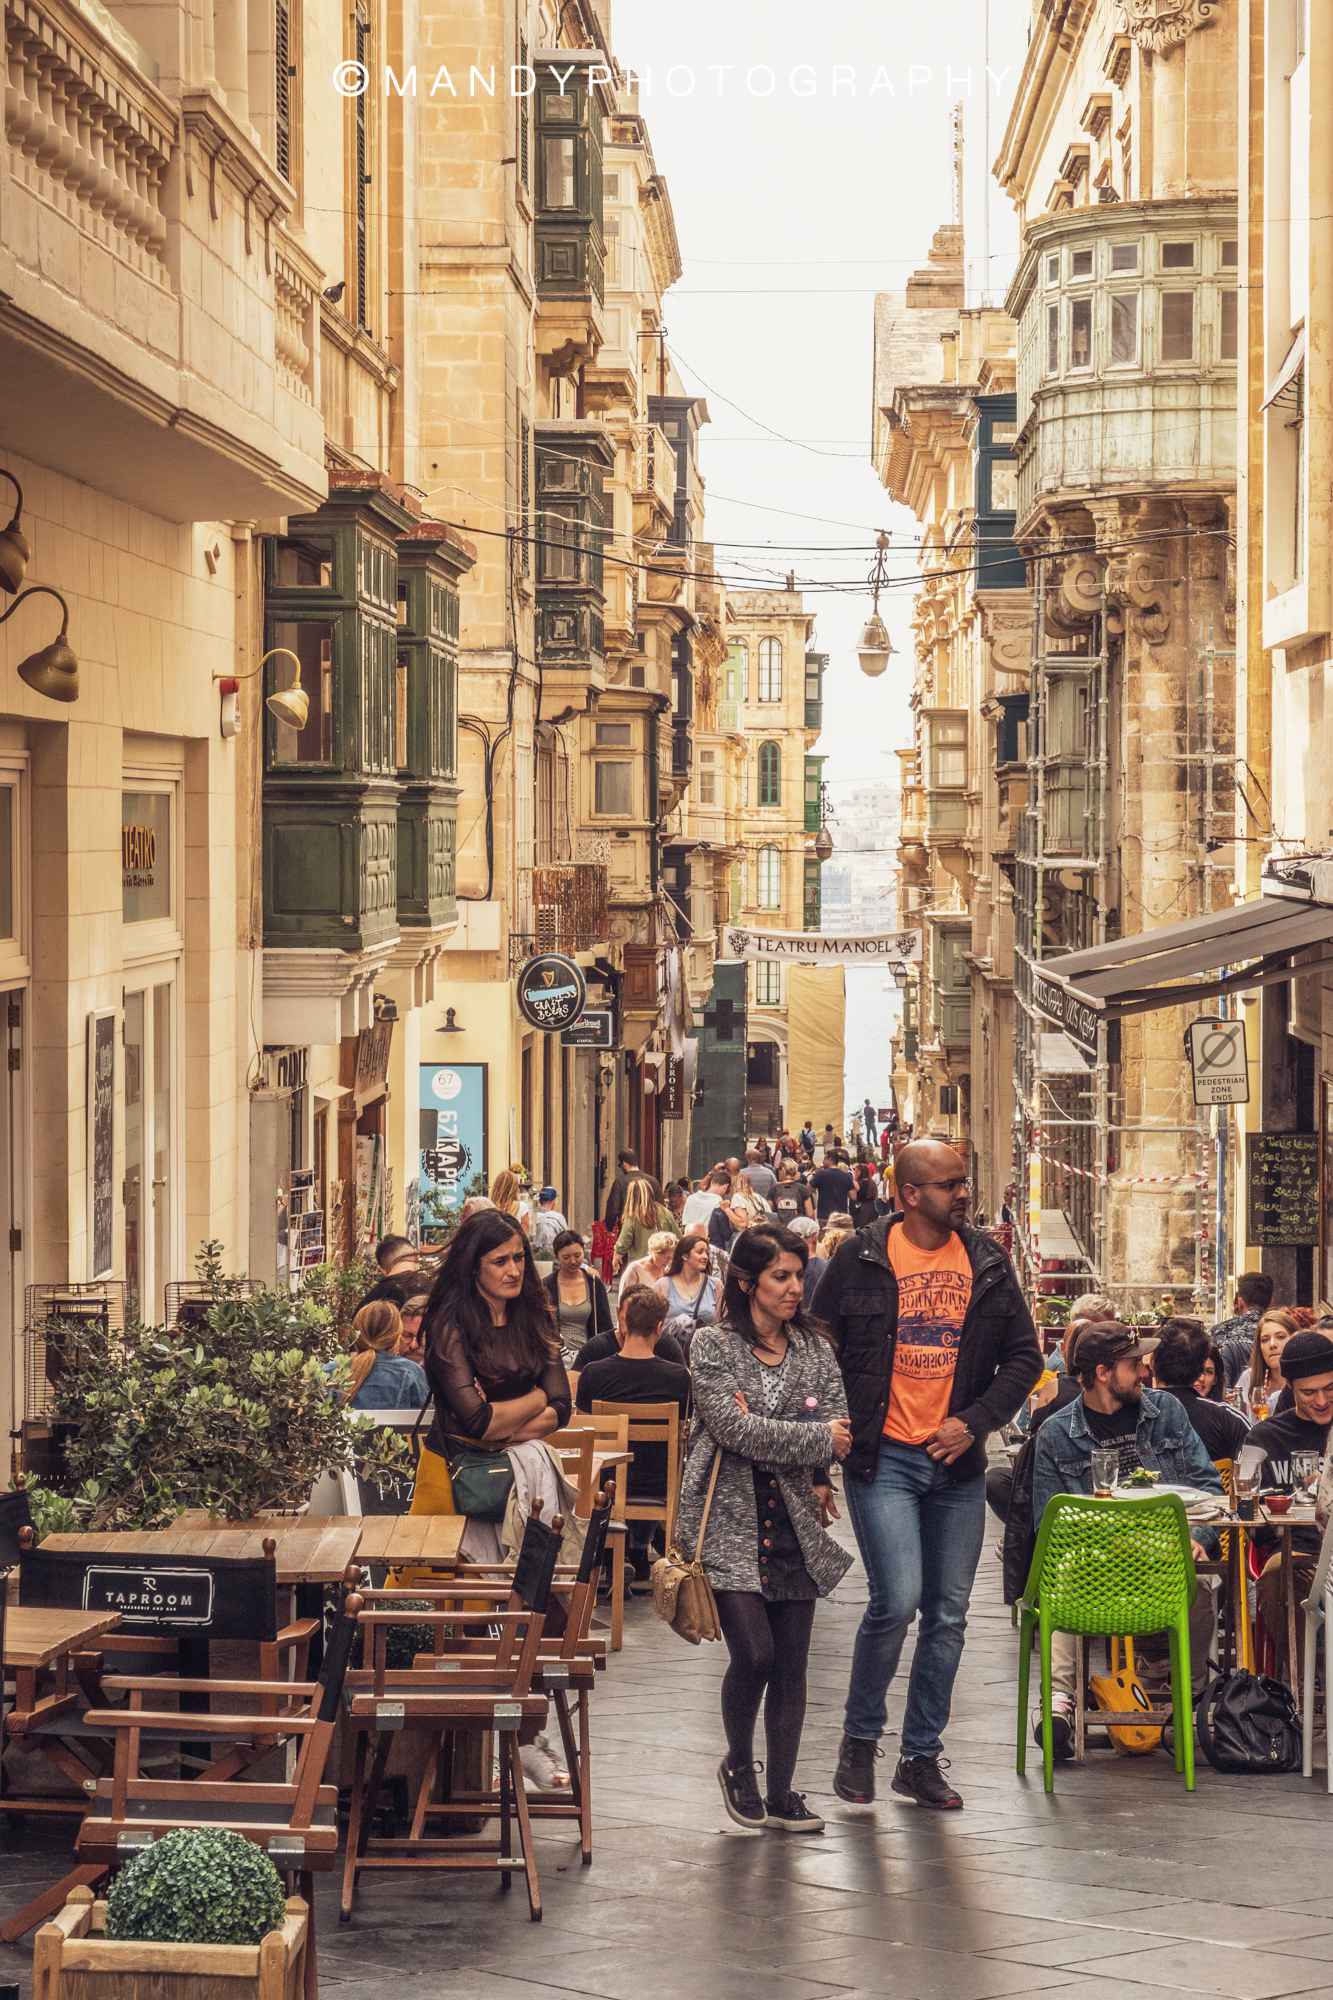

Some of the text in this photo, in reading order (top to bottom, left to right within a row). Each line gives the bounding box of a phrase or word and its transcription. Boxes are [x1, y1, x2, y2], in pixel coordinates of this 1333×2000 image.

[753, 936, 892, 953] TEATRU MANOEL
[1198, 1077, 1245, 1086] PEDESTRIAN
[1211, 1086, 1232, 1094] ZONE
[1211, 1094, 1233, 1102] ENDS
[105, 1592, 192, 1606] TAPROOM
